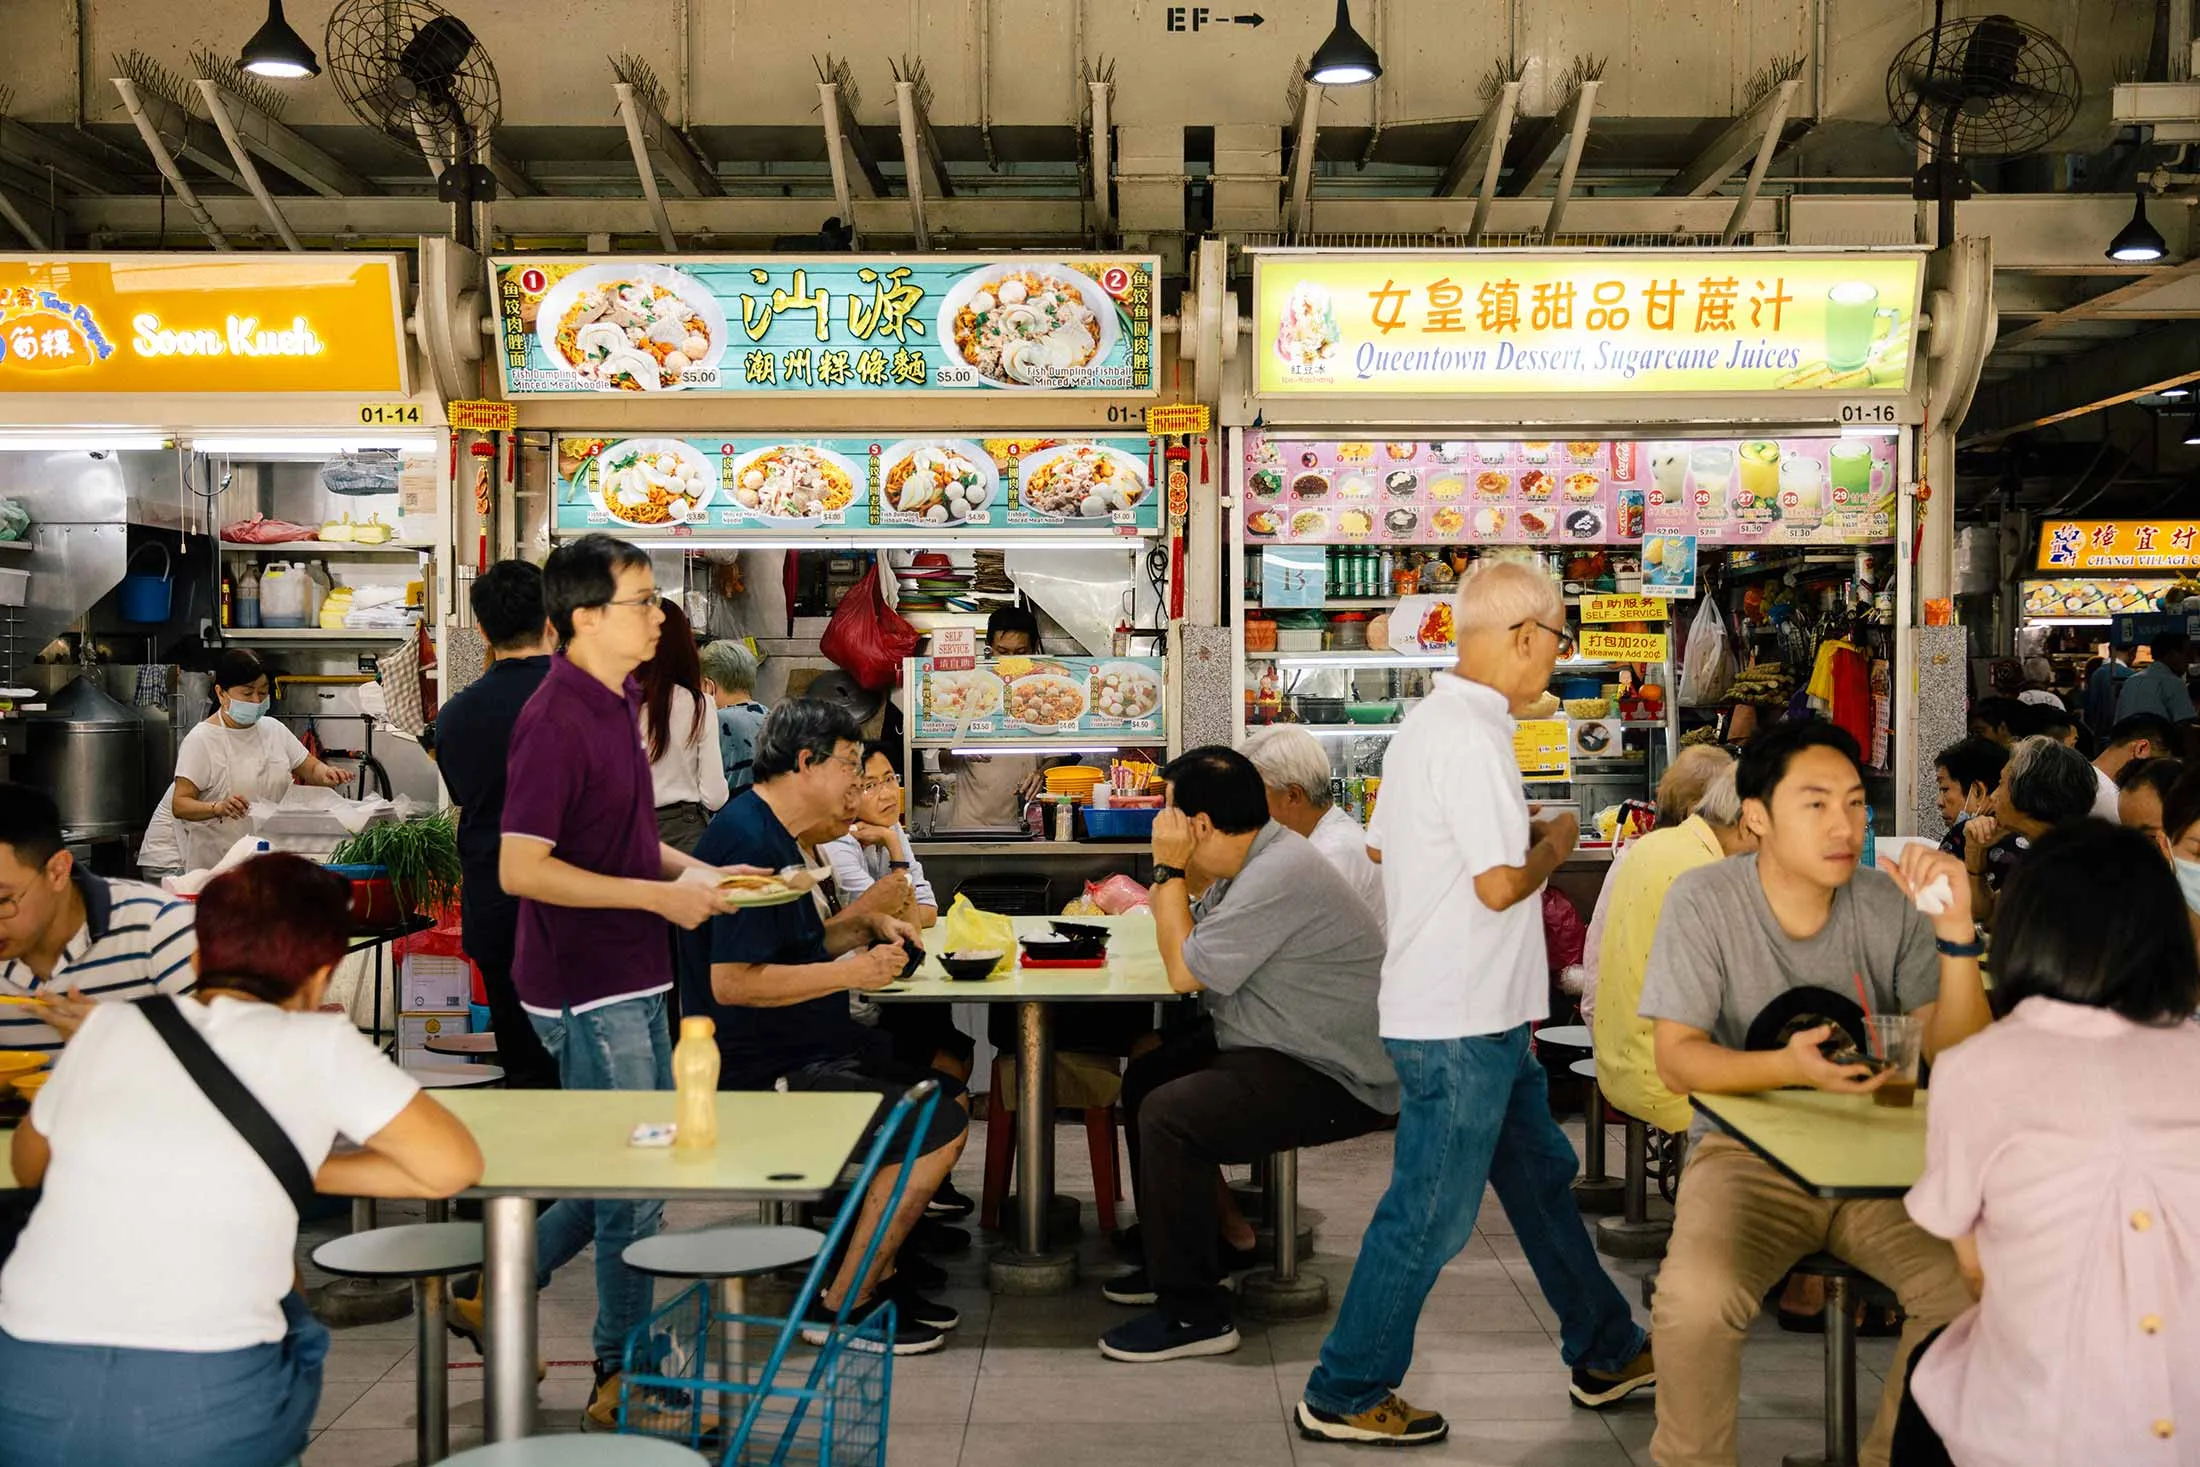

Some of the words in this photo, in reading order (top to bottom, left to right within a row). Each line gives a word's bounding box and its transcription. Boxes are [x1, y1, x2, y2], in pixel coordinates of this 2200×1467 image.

[1167, 7, 1209, 32] EF
[740, 268, 925, 343] 汕源
[1369, 276, 1793, 334] 女皇镇甜品甘蔗汁
[73, 304, 114, 360] Payoh
[133, 313, 225, 357] Soon
[226, 314, 324, 357] Kueh
[1355, 341, 1486, 380] Queentown
[1495, 341, 1585, 374] Dessert,
[1594, 339, 1722, 379] Sugarcane
[1725, 339, 1800, 369] Juices
[512, 370, 533, 380] Fish
[533, 370, 577, 381] Dumpling
[936, 370, 971, 383] $5.00
[1027, 367, 1046, 376] Fish
[1095, 367, 1131, 376] Fishball
[682, 371, 716, 384] $5.00
[1035, 378, 1069, 386] Minced
[1072, 378, 1096, 386] Meat
[1099, 378, 1132, 386] Noodle
[513, 381, 546, 389] Minced
[550, 381, 575, 389] Meat
[577, 381, 610, 389] Noodle
[361, 407, 419, 422] 01-14
[1107, 406, 1146, 422] 01-1
[1842, 405, 1895, 421] 01-16
[1649, 494, 1663, 502] 25
[1695, 494, 1709, 502] 26
[1740, 493, 1753, 501] 27
[1784, 496, 1798, 504] 28
[1834, 492, 1847, 500] 29
[2087, 555, 2135, 566] CHANGI
[2138, 555, 2189, 566] VILLAGE
[1591, 598, 1655, 610] 自助服务
[1585, 610, 1610, 619] SELF
[1619, 608, 1663, 618] SERVICE
[944, 631, 963, 641] SELF
[939, 643, 970, 654] SERVICE
[1584, 648, 1624, 658] Takeaway
[1625, 650, 1641, 658] Add
